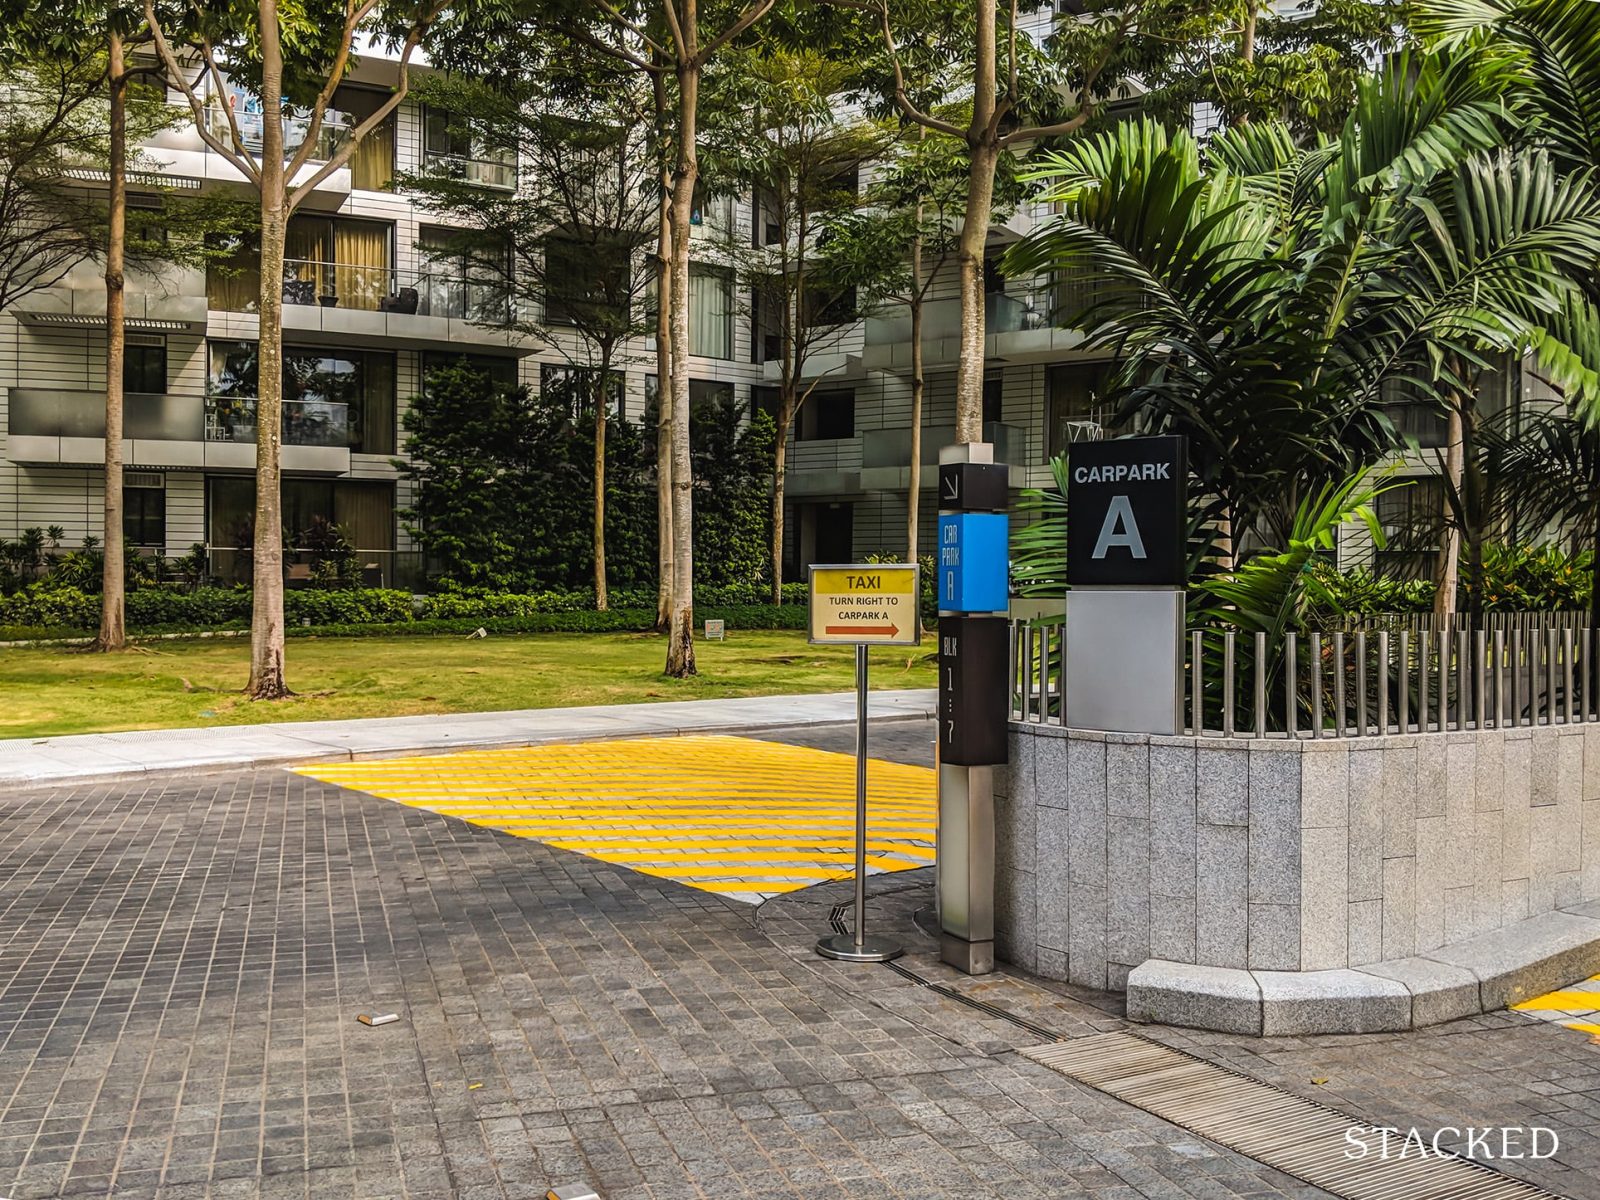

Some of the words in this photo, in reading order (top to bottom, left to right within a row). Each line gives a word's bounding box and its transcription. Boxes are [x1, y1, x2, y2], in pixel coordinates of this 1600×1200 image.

[1074, 462, 1170, 484] CARPARK
[944, 524, 958, 544] CAR
[1091, 495, 1147, 559] A
[942, 547, 960, 567] PARK
[846, 575, 881, 589] TAXI
[947, 571, 954, 601] A
[829, 597, 854, 606] TURN
[856, 597, 883, 606] RIGHT
[885, 597, 899, 606] TO
[838, 611, 880, 620] CARPARK
[881, 611, 889, 620] A
[943, 636, 957, 656] BLK
